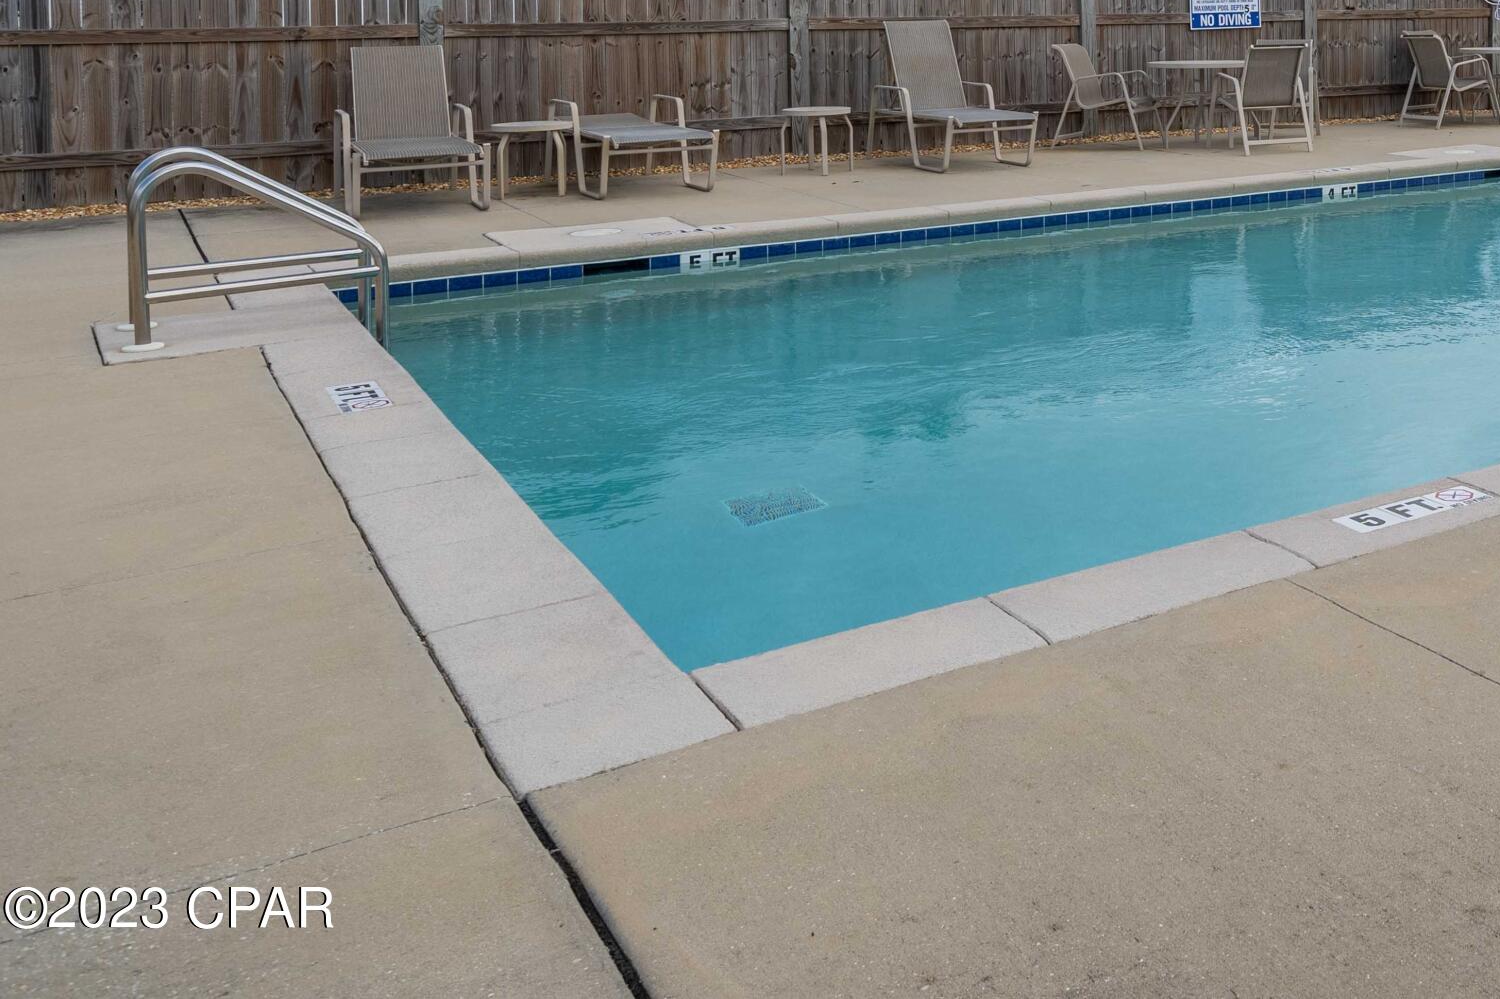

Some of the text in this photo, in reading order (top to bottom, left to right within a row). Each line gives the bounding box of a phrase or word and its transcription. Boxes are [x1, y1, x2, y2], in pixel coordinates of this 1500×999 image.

[1200, 13, 1252, 27] NO DIVING
[1350, 513, 1386, 527] 5
